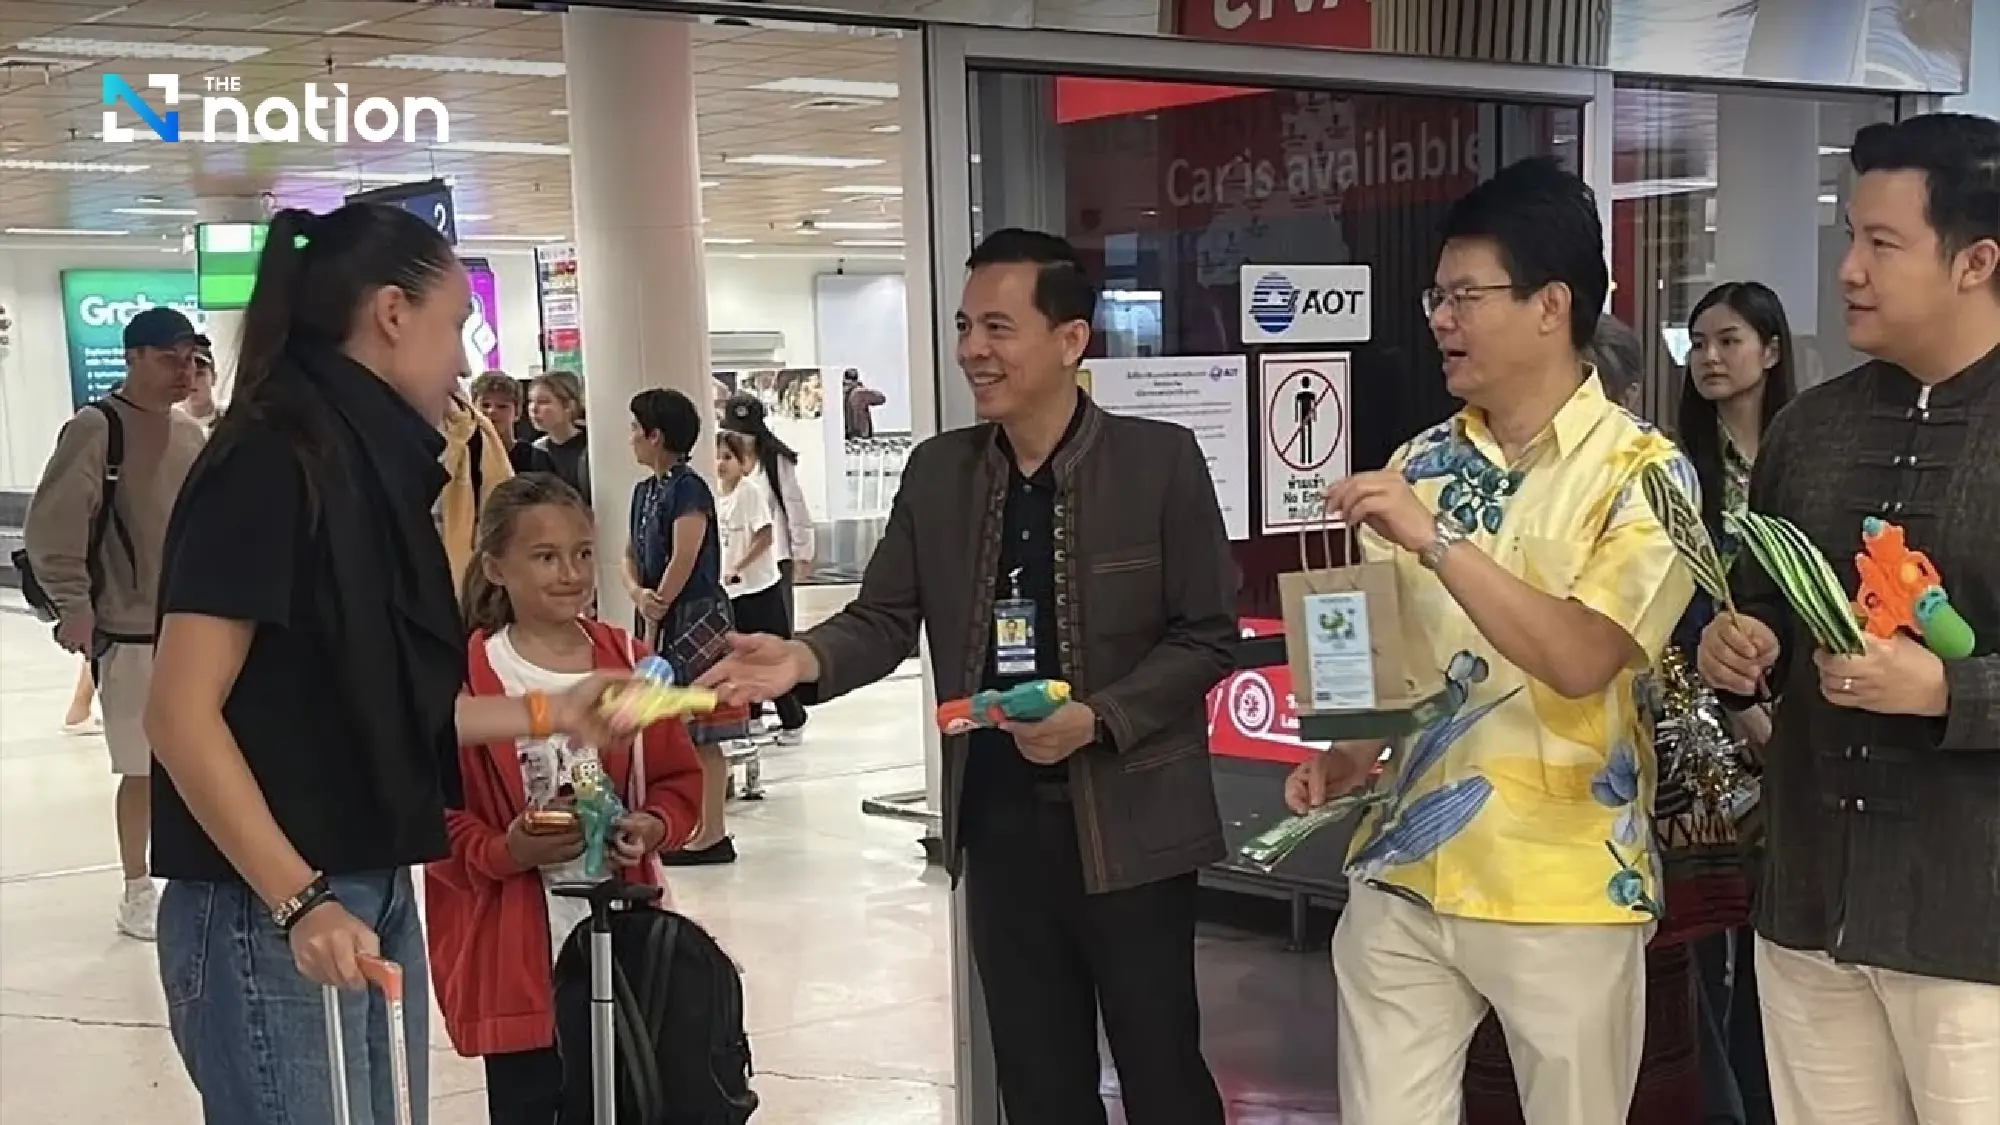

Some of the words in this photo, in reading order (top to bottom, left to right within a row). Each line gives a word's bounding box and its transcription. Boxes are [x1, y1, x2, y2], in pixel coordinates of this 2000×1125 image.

[1166, 157, 1232, 207] Car
[1243, 147, 1276, 198] is
[1284, 116, 1481, 196] available
[1301, 289, 1364, 315] AOT
[1283, 491, 1298, 504] No
